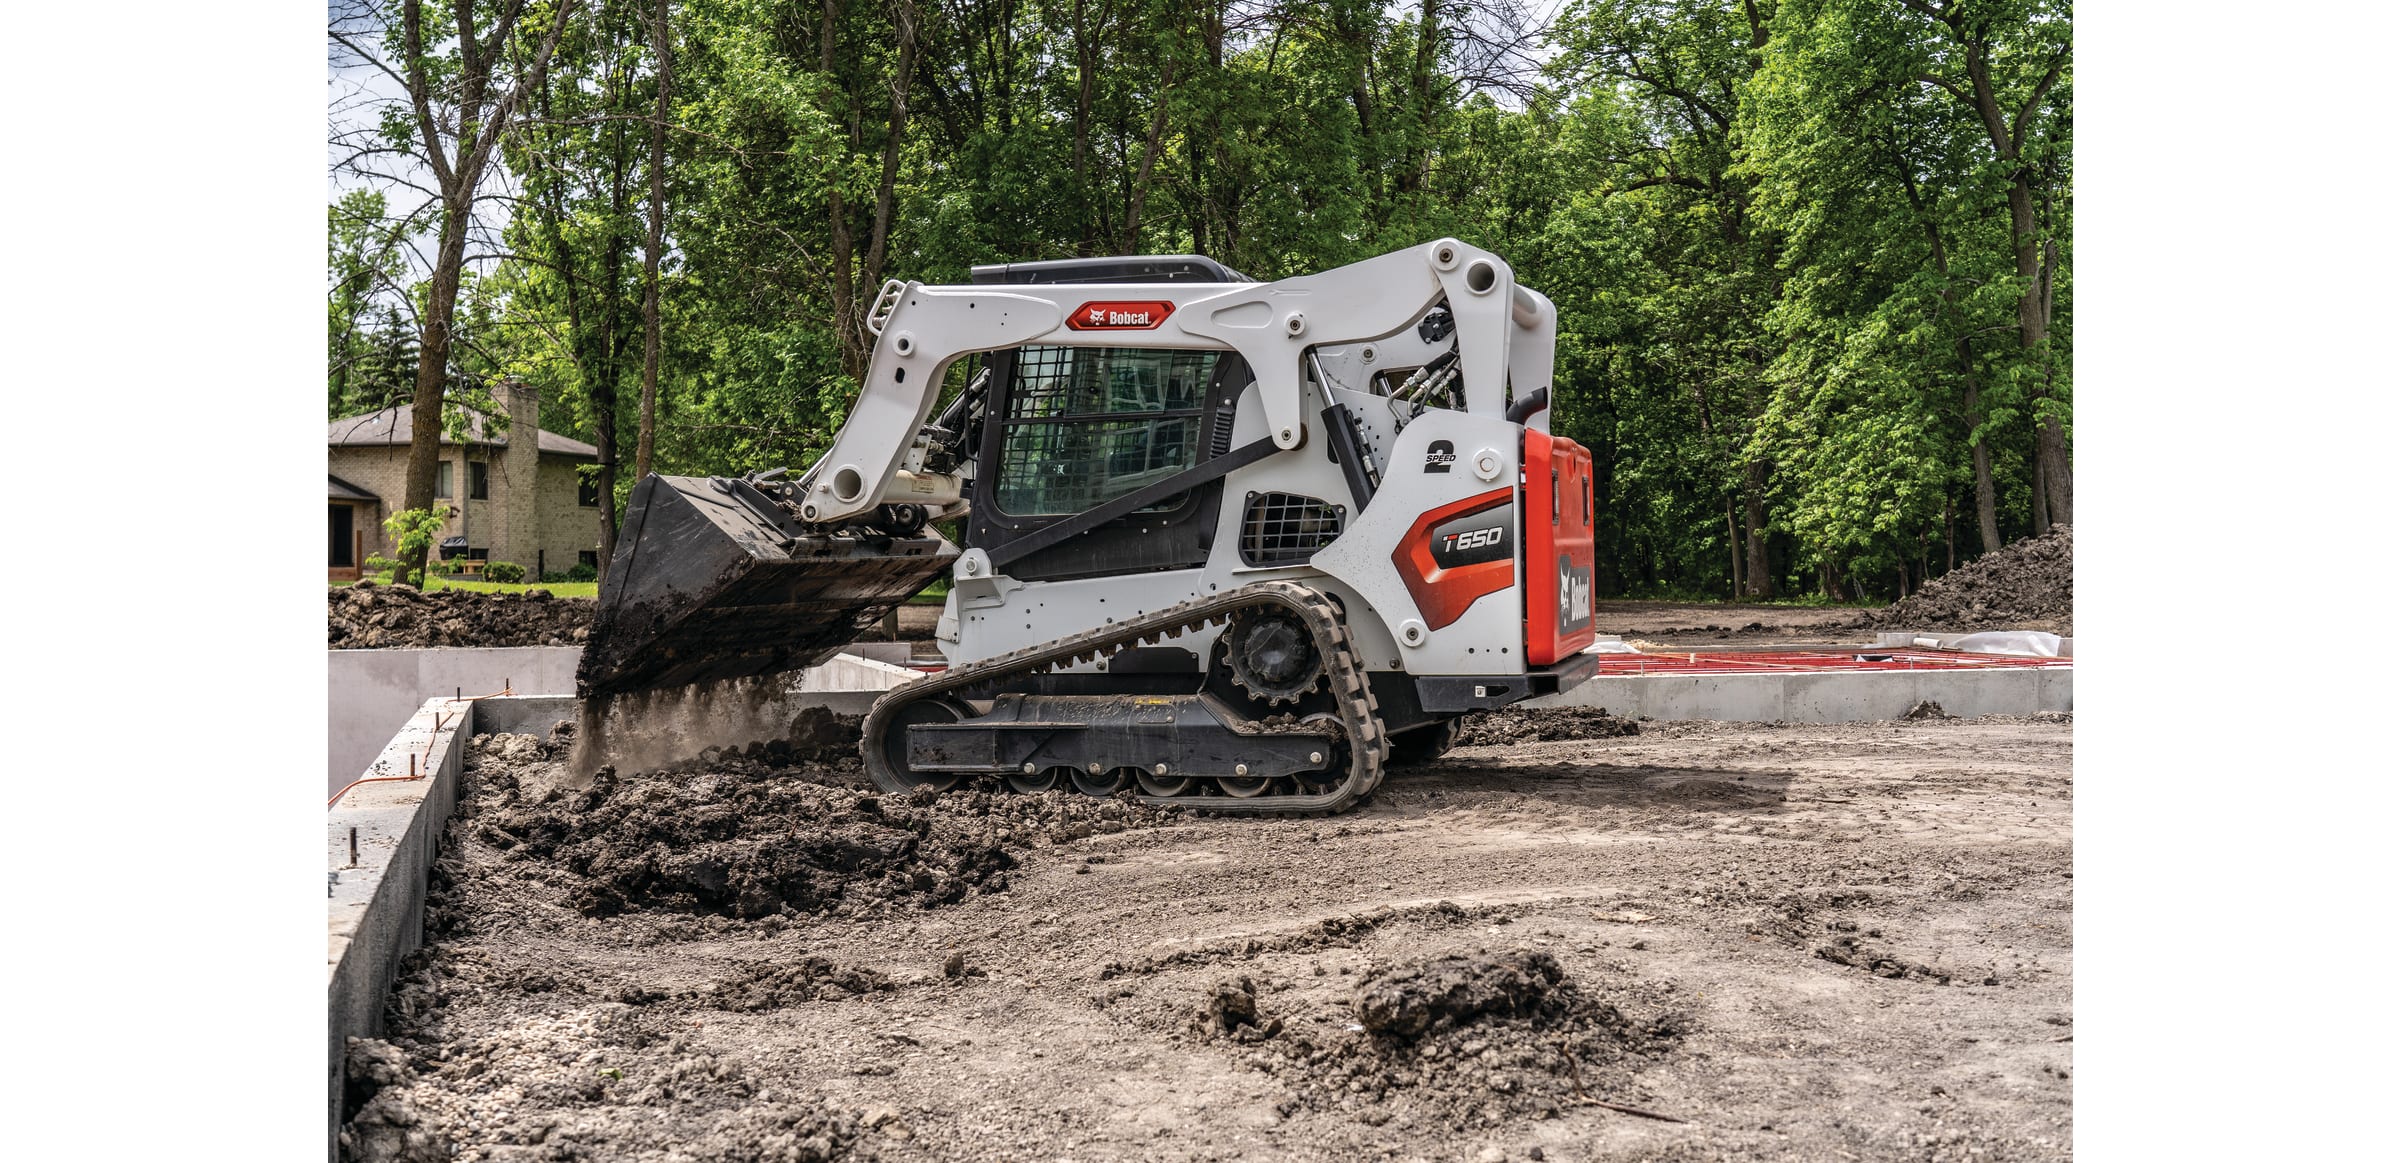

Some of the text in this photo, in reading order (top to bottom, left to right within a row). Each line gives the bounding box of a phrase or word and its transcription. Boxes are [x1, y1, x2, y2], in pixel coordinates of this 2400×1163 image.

[1109, 311, 1149, 325] Bobcat
[1424, 439, 1454, 473] 2
[1425, 454, 1456, 462] SPEED
[1442, 526, 1503, 552] T650
